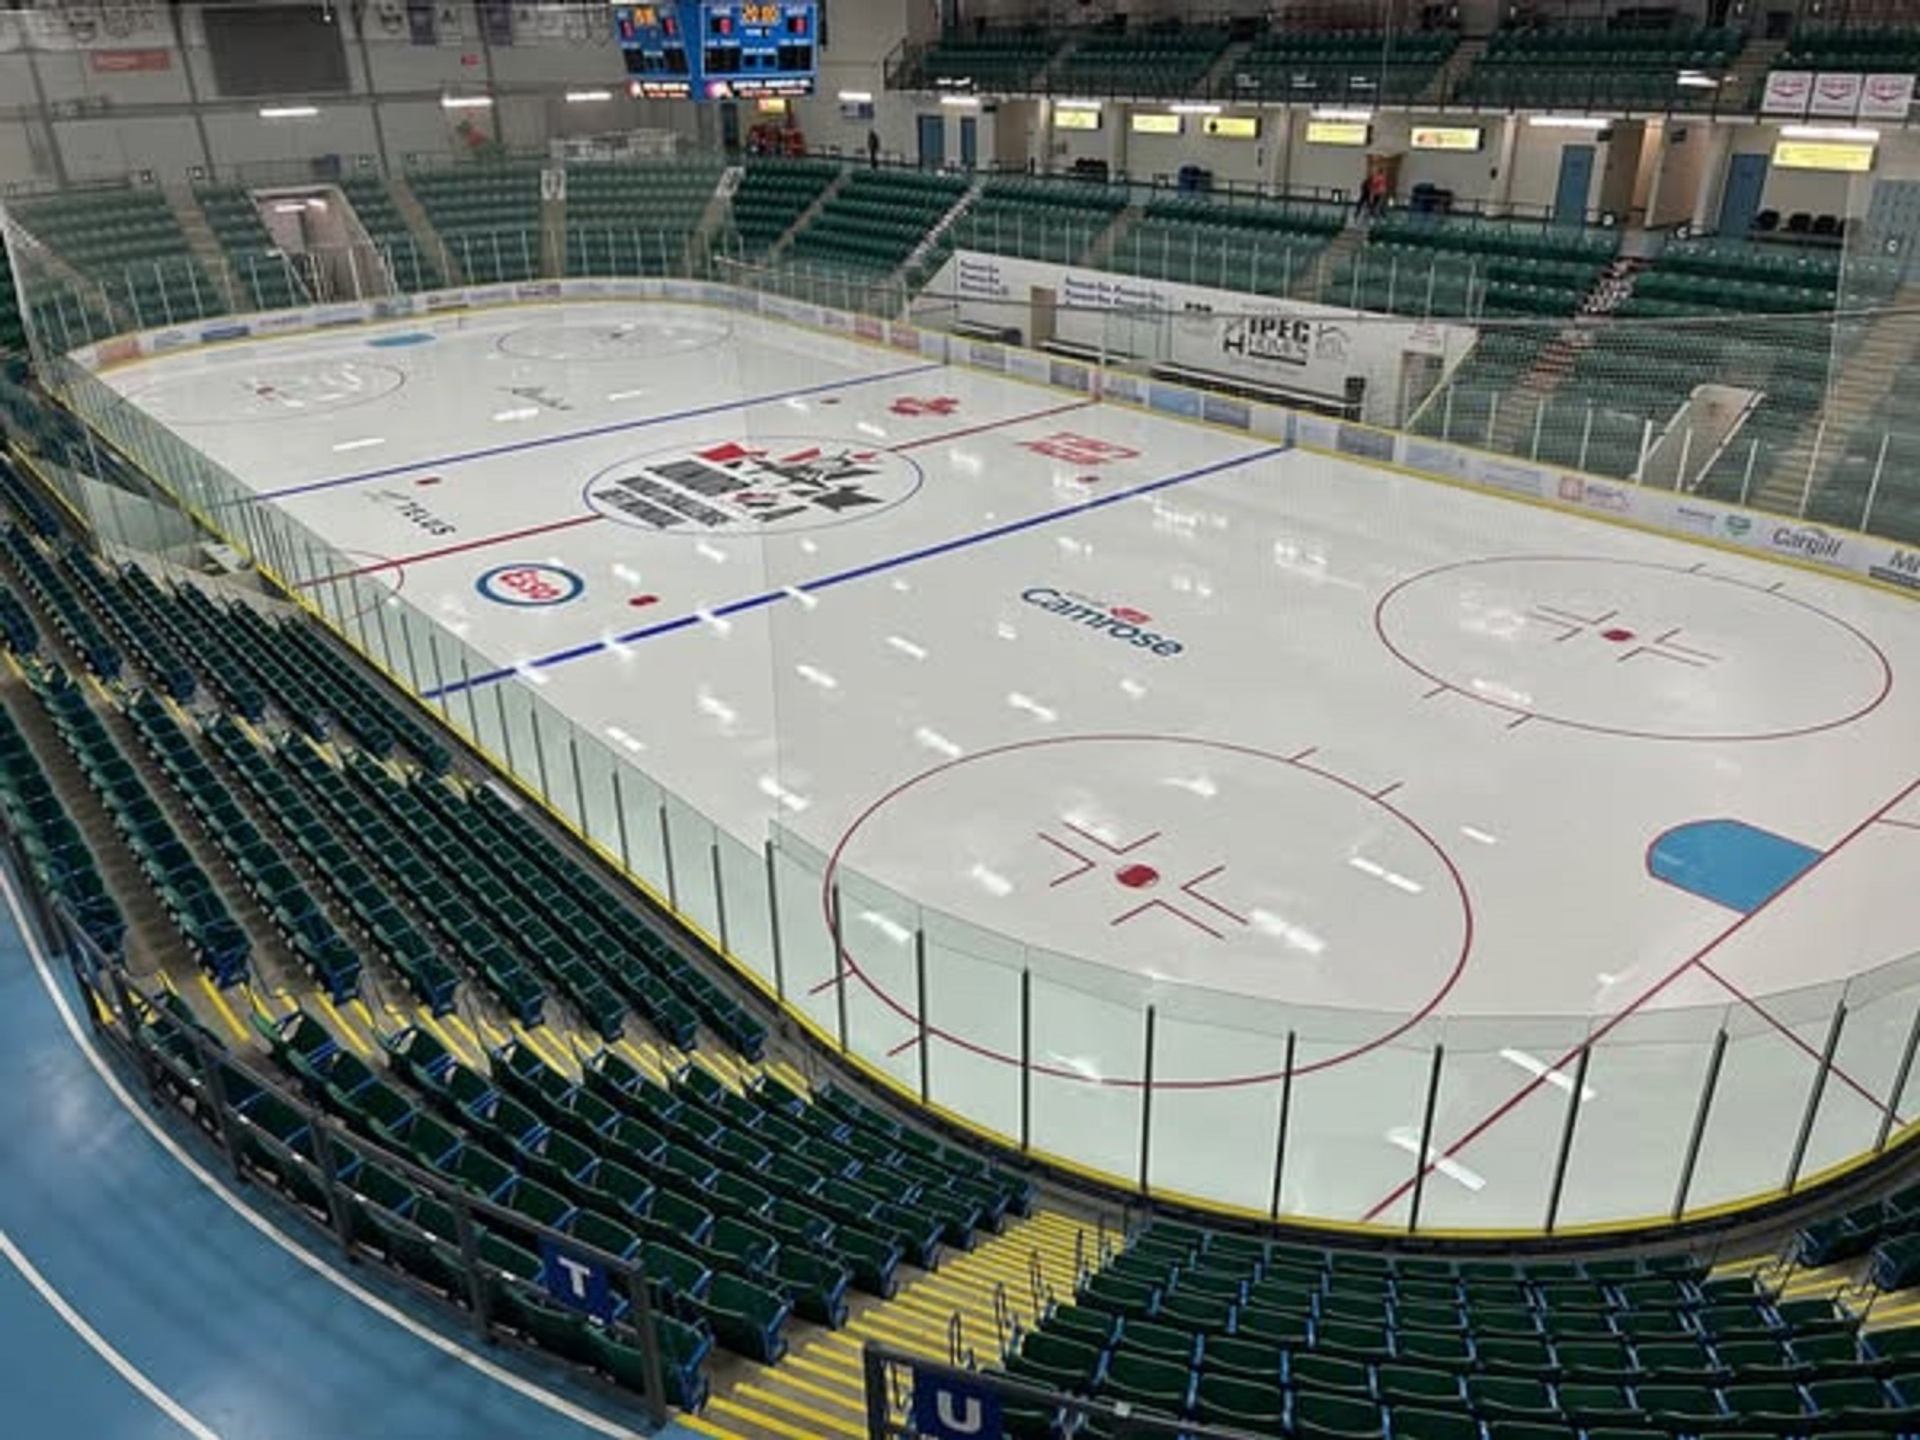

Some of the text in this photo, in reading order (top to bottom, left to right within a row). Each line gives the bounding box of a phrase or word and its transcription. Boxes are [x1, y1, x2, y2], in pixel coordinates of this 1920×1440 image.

[1773, 528, 1842, 557] Cargill
[1021, 587, 1183, 657] Camrose
[557, 1255, 591, 1299] T
[936, 1388, 982, 1434] U
